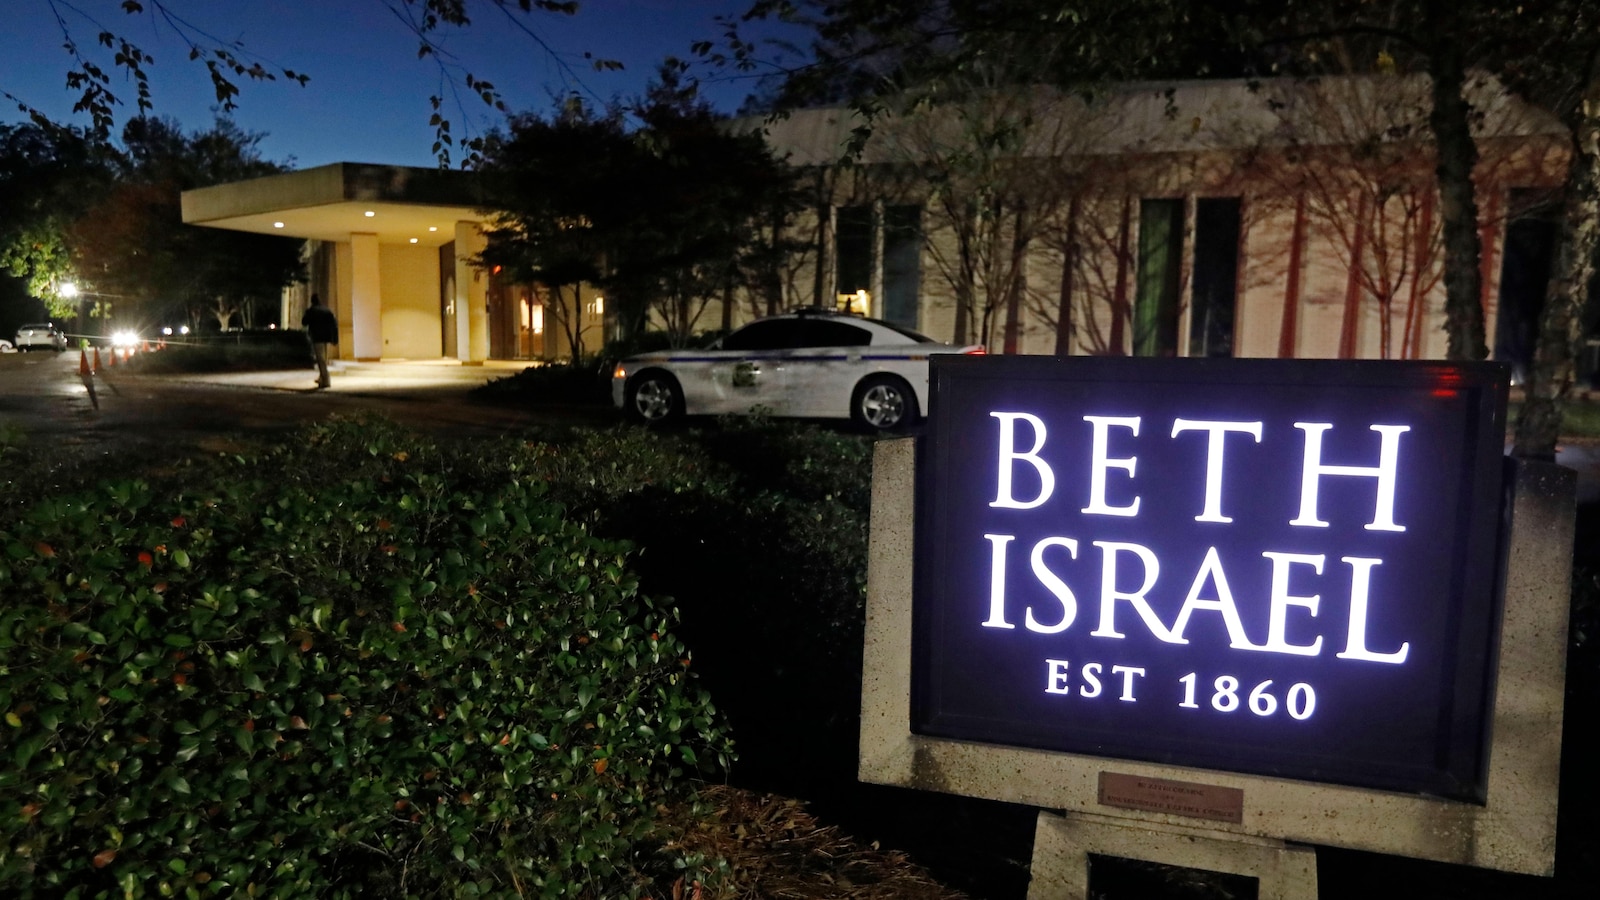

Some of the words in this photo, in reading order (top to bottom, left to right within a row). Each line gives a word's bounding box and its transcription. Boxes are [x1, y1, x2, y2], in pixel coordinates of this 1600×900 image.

[988, 411, 1412, 533] BETH
[981, 533, 1410, 665] ISRAEL
[1044, 658, 1147, 703] EST
[1178, 672, 1317, 721] 1860
